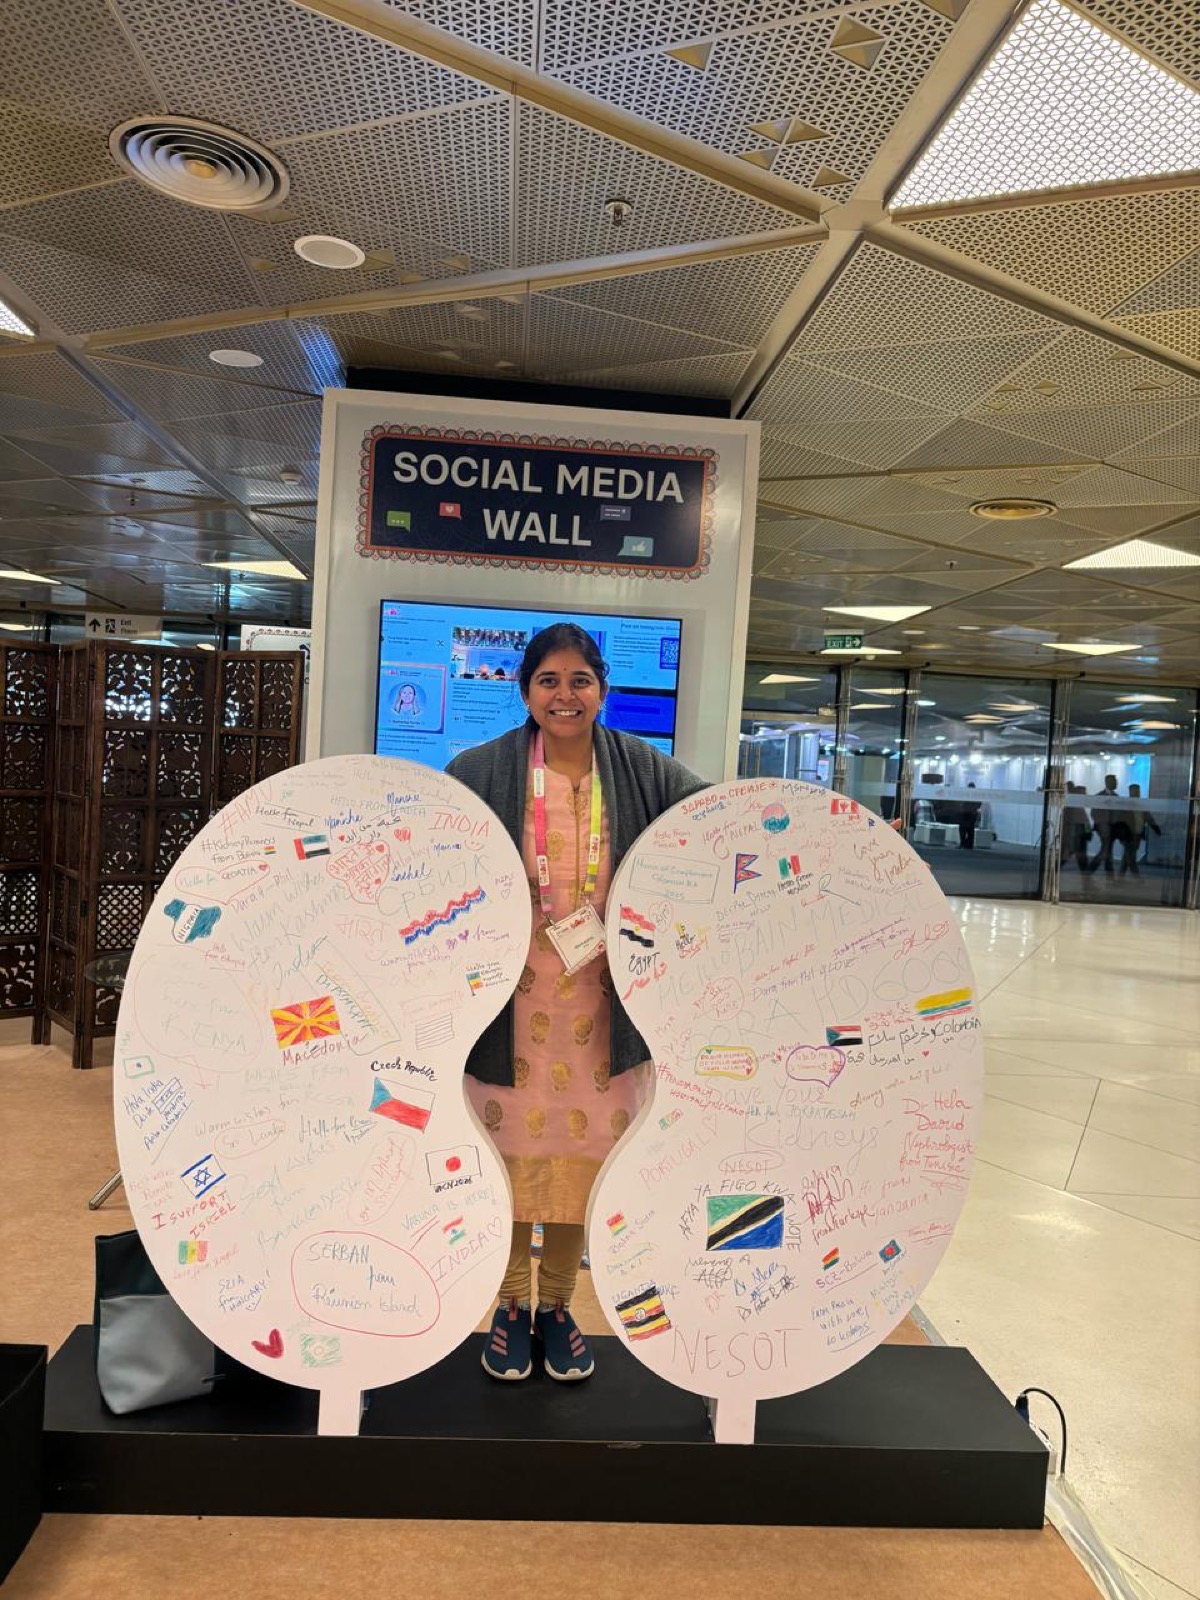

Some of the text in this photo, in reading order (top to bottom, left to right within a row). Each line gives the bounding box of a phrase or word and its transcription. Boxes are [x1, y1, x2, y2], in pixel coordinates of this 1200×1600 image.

[393, 451, 686, 504] SOCIAL MEDIA
[482, 507, 593, 547] WALL
[827, 640, 843, 648] EXIT
[428, 811, 490, 838] INDIA
[371, 1056, 438, 1082] Czech Republic
[152, 1212, 167, 1230] I
[680, 1203, 700, 1240] AFYA
[719, 1179, 757, 1193] FIGO
[785, 1213, 801, 1252] WOTE
[305, 1240, 370, 1264] SERBAN
[429, 1231, 490, 1283] INDIA
[672, 1327, 804, 1378] NESOT
